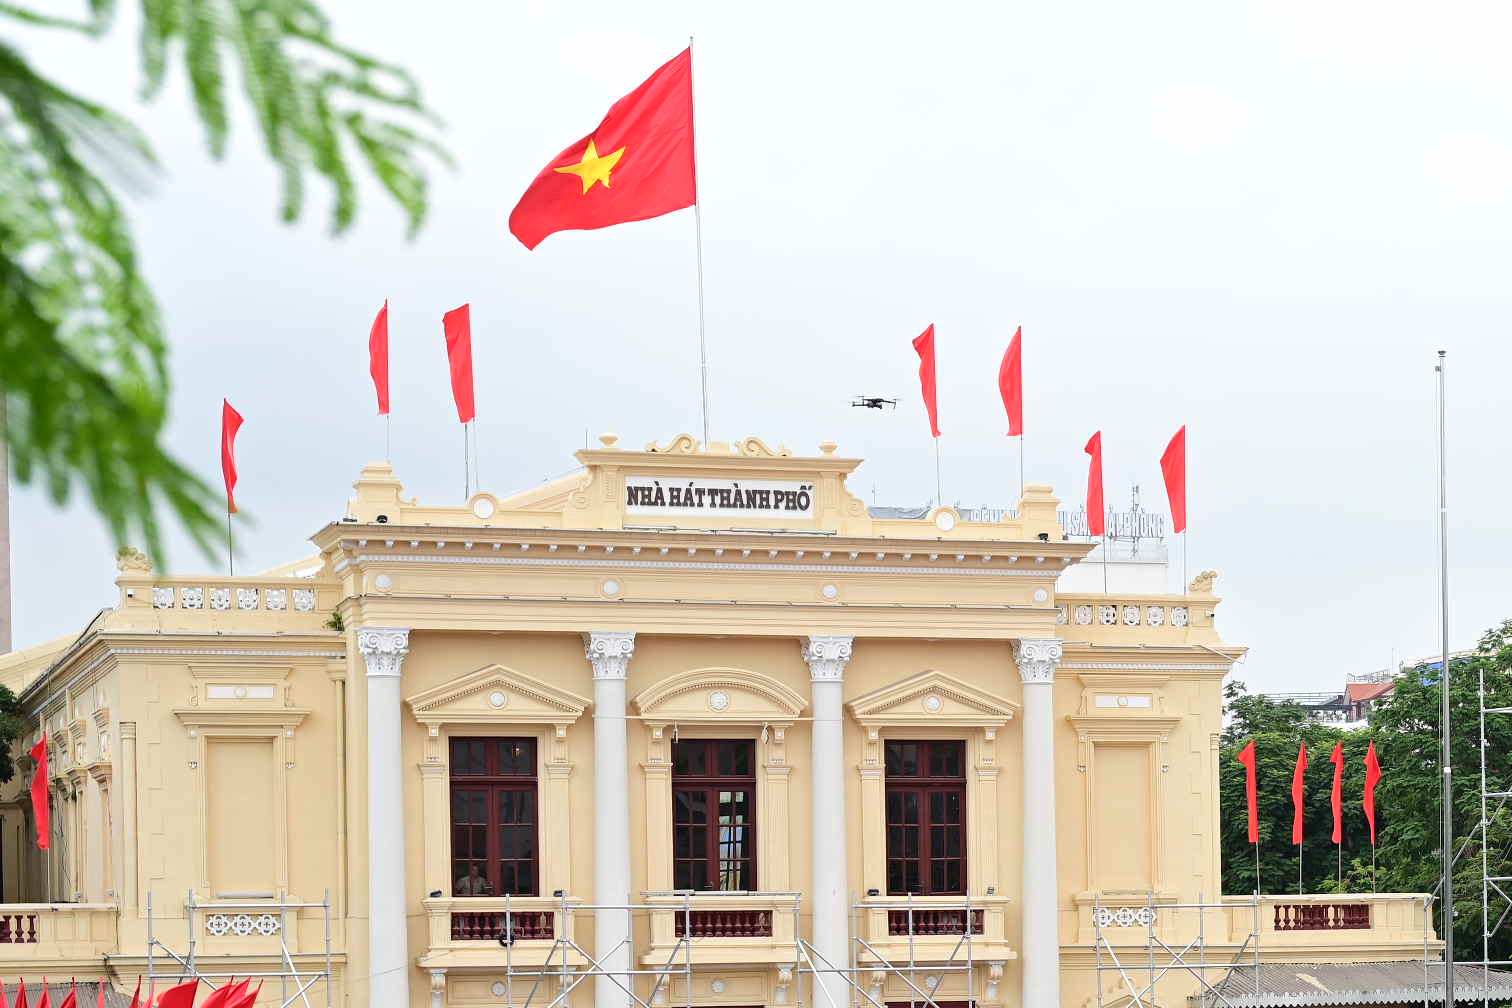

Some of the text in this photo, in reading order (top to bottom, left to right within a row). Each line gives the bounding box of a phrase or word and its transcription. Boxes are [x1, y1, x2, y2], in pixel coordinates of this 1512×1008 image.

[627, 481, 813, 512] NHÀ HÁT THÀNH PHỐ
